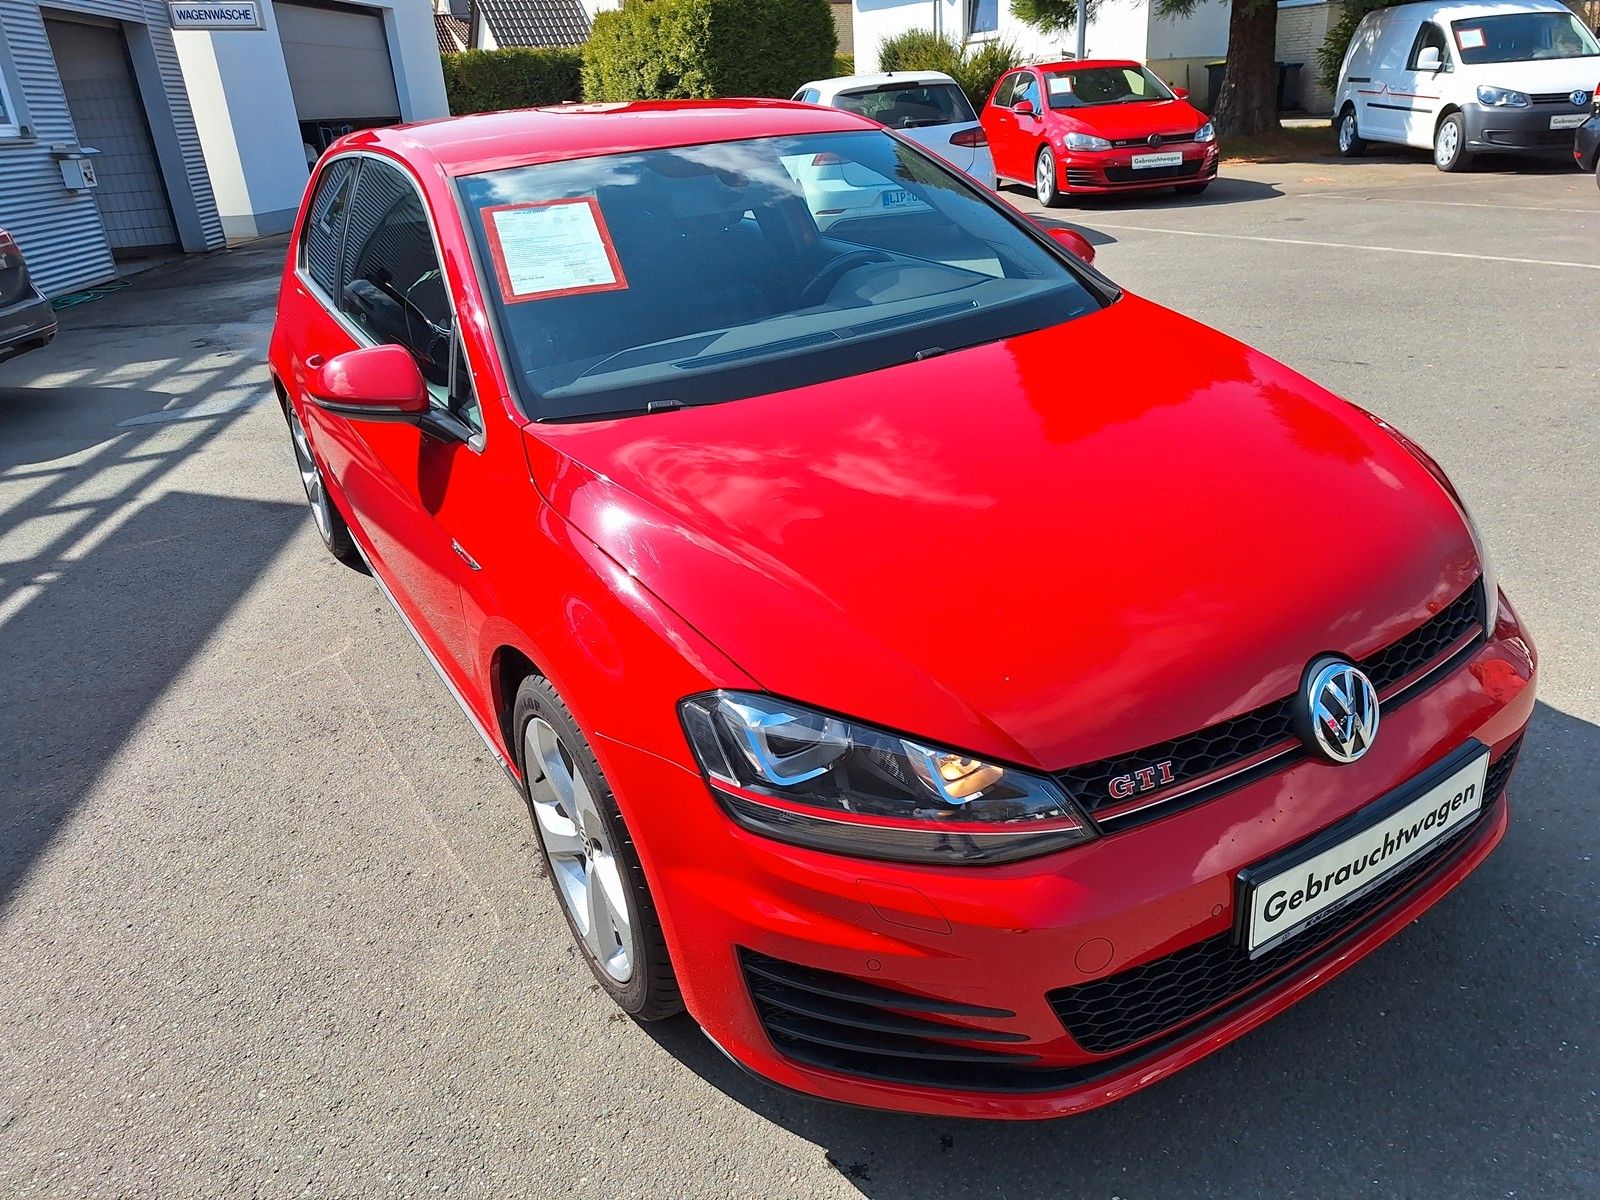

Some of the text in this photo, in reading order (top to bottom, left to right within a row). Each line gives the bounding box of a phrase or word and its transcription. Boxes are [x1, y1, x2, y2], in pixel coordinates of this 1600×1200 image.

[176, 8, 252, 20] WAGENWÄSCHE
[1134, 156, 1180, 164] Gebrauchtwagen
[890, 191, 906, 203] LIP
[1309, 663, 1380, 764] VW
[1108, 761, 1175, 799] GTI
[1263, 783, 1476, 923] Gebrauchtwagen
